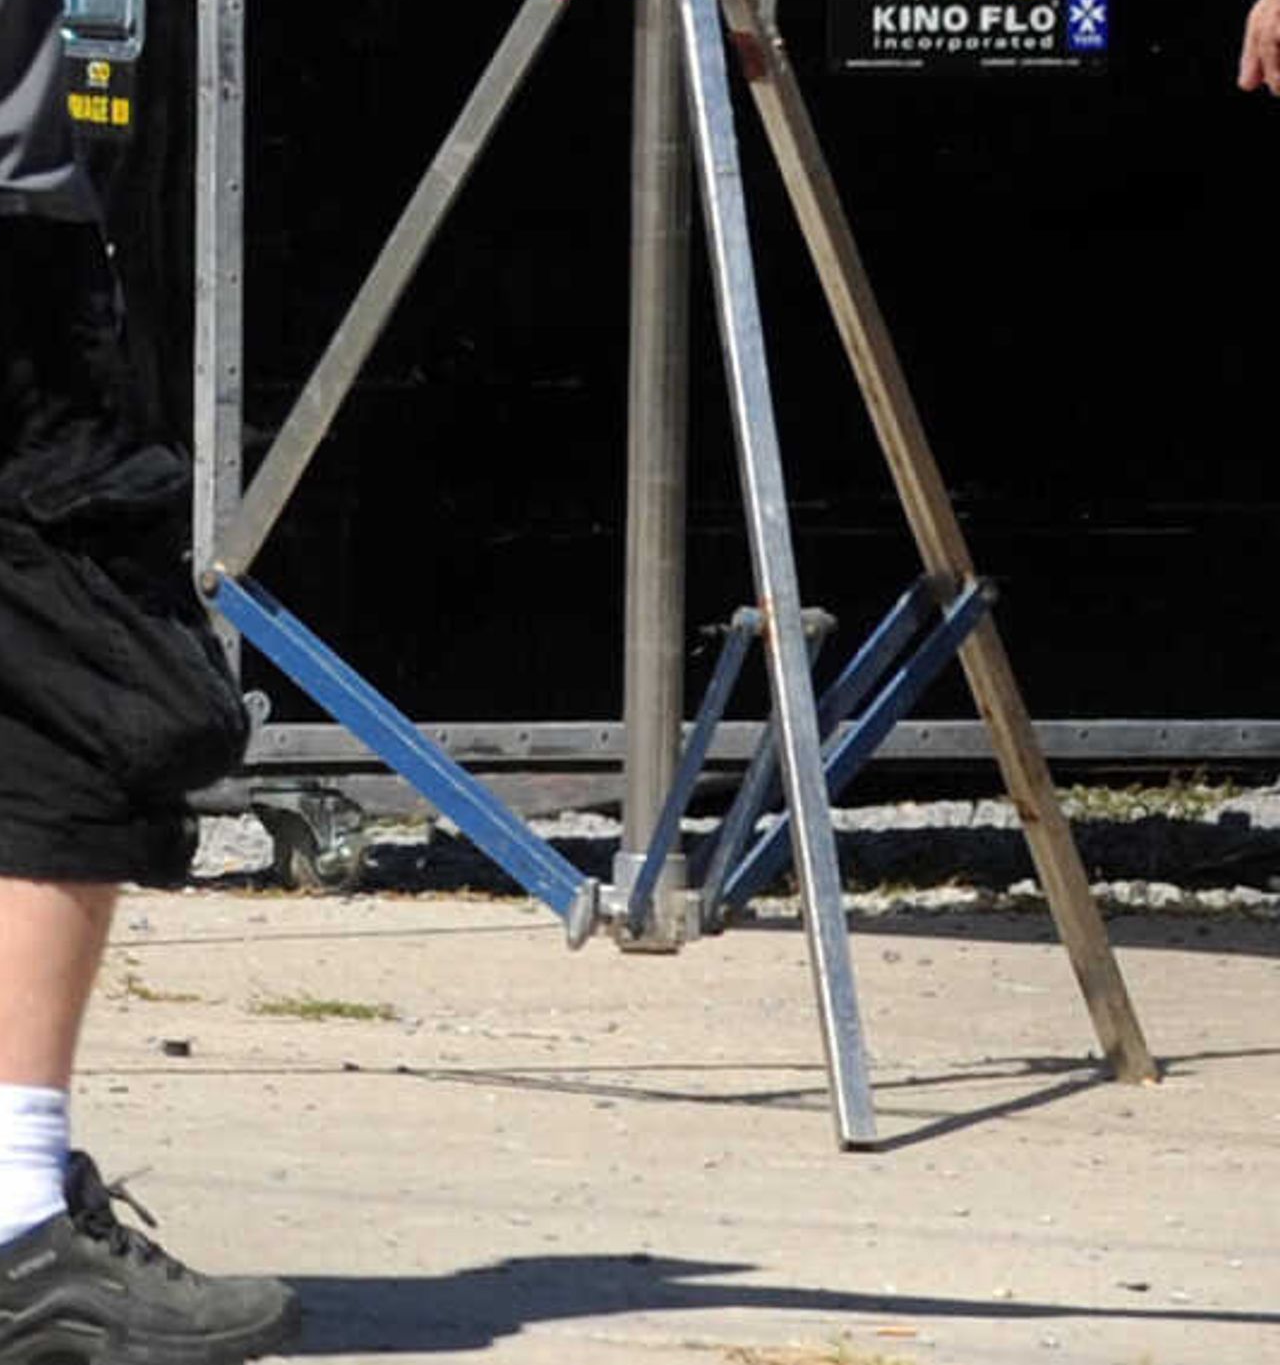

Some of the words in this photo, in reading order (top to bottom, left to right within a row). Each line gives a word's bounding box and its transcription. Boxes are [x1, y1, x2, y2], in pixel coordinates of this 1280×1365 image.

[872, 4, 969, 33] KINO
[979, 4, 1057, 33] FLO
[873, 34, 1054, 53] incorporated
